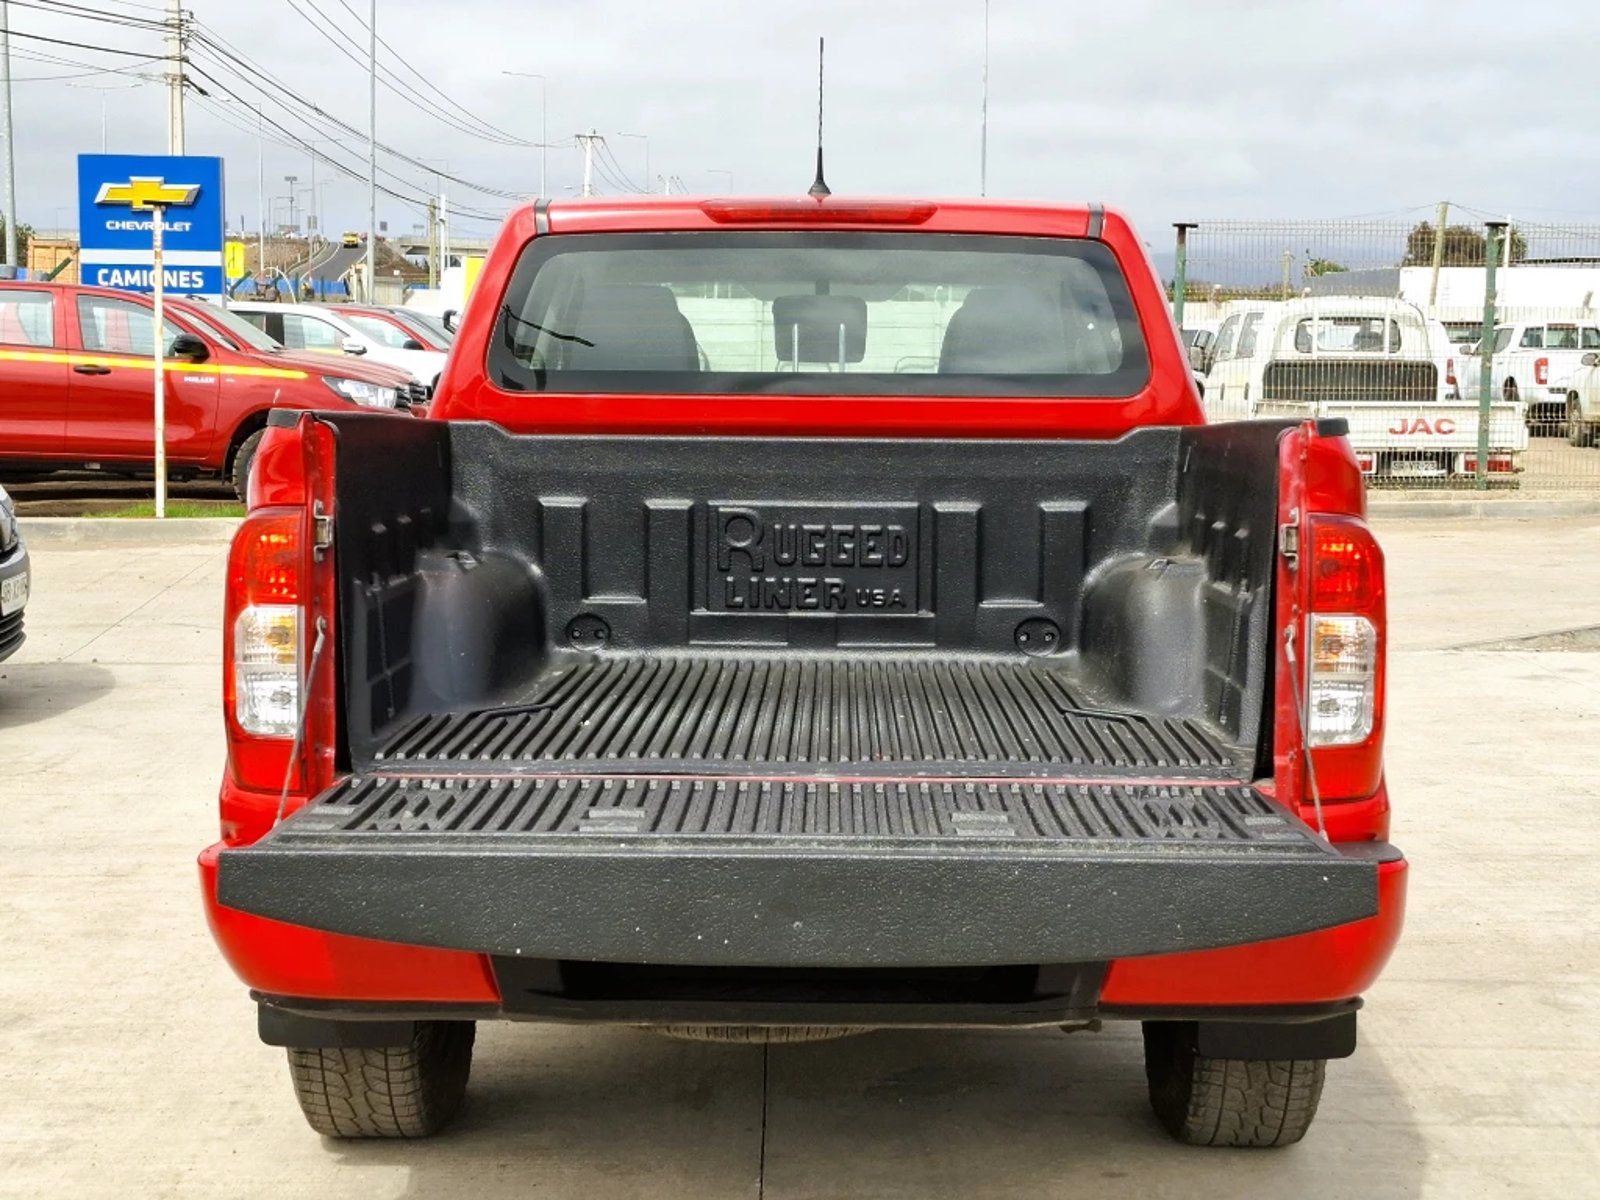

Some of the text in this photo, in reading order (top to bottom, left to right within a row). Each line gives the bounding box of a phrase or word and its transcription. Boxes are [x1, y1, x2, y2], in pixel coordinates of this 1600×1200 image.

[1388, 418, 1456, 434] JAC
[717, 507, 909, 572] RUGGED
[725, 576, 905, 609] LINER USA
